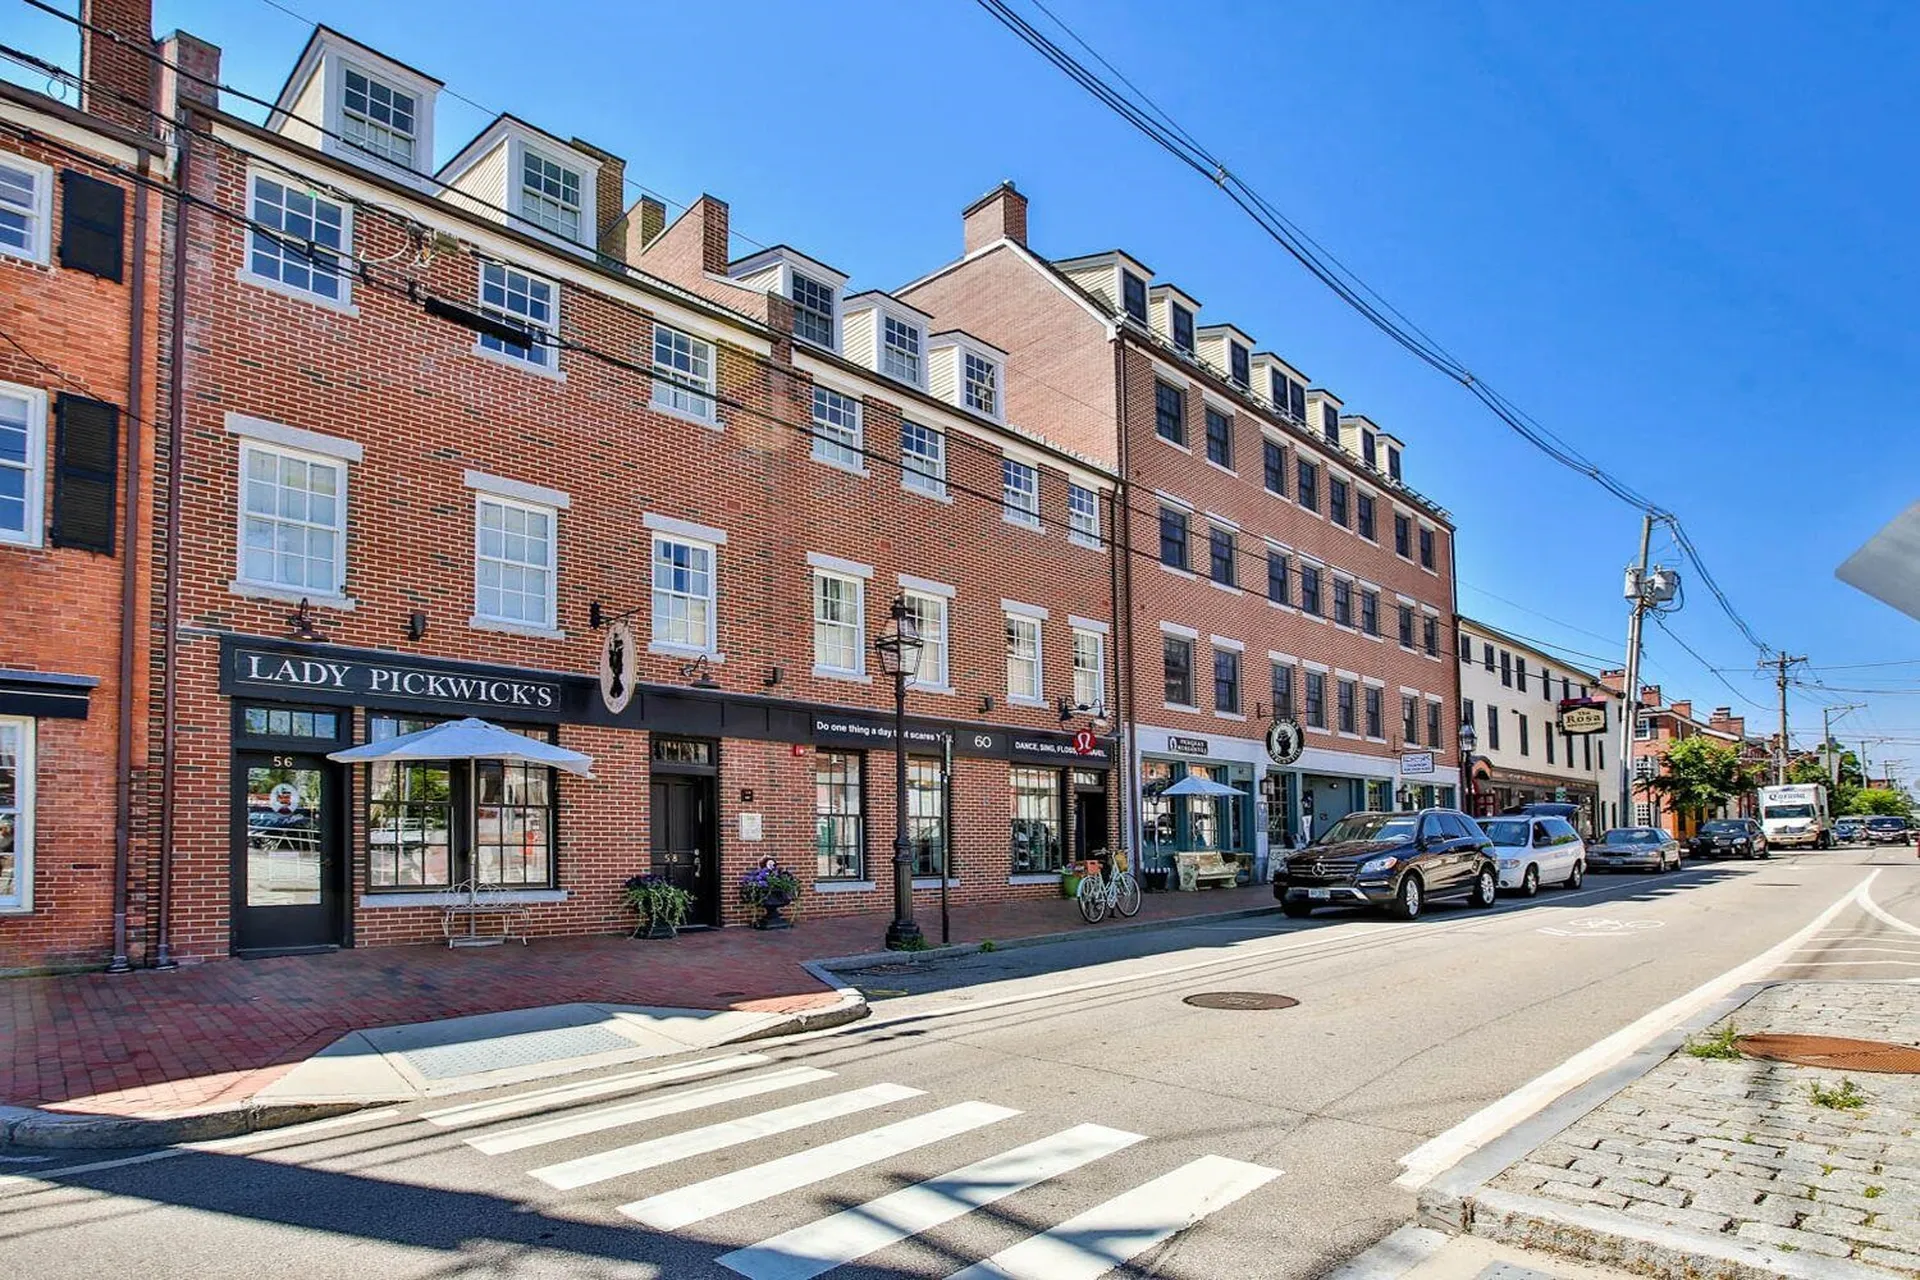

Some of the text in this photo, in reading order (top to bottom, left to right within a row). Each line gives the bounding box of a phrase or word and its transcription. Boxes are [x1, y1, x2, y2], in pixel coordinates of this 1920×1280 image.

[248, 656, 552, 707] LADY PICKWICK'S
[1566, 714, 1601, 723] Rosa
[816, 721, 829, 731] Do
[830, 725, 847, 733] one
[848, 724, 870, 736] thing
[877, 727, 893, 738] day
[910, 732, 935, 741] scares
[974, 735, 992, 748] 60
[1014, 741, 1039, 751] DANCE,
[1039, 744, 1057, 753] SING,
[273, 755, 293, 767] 56
